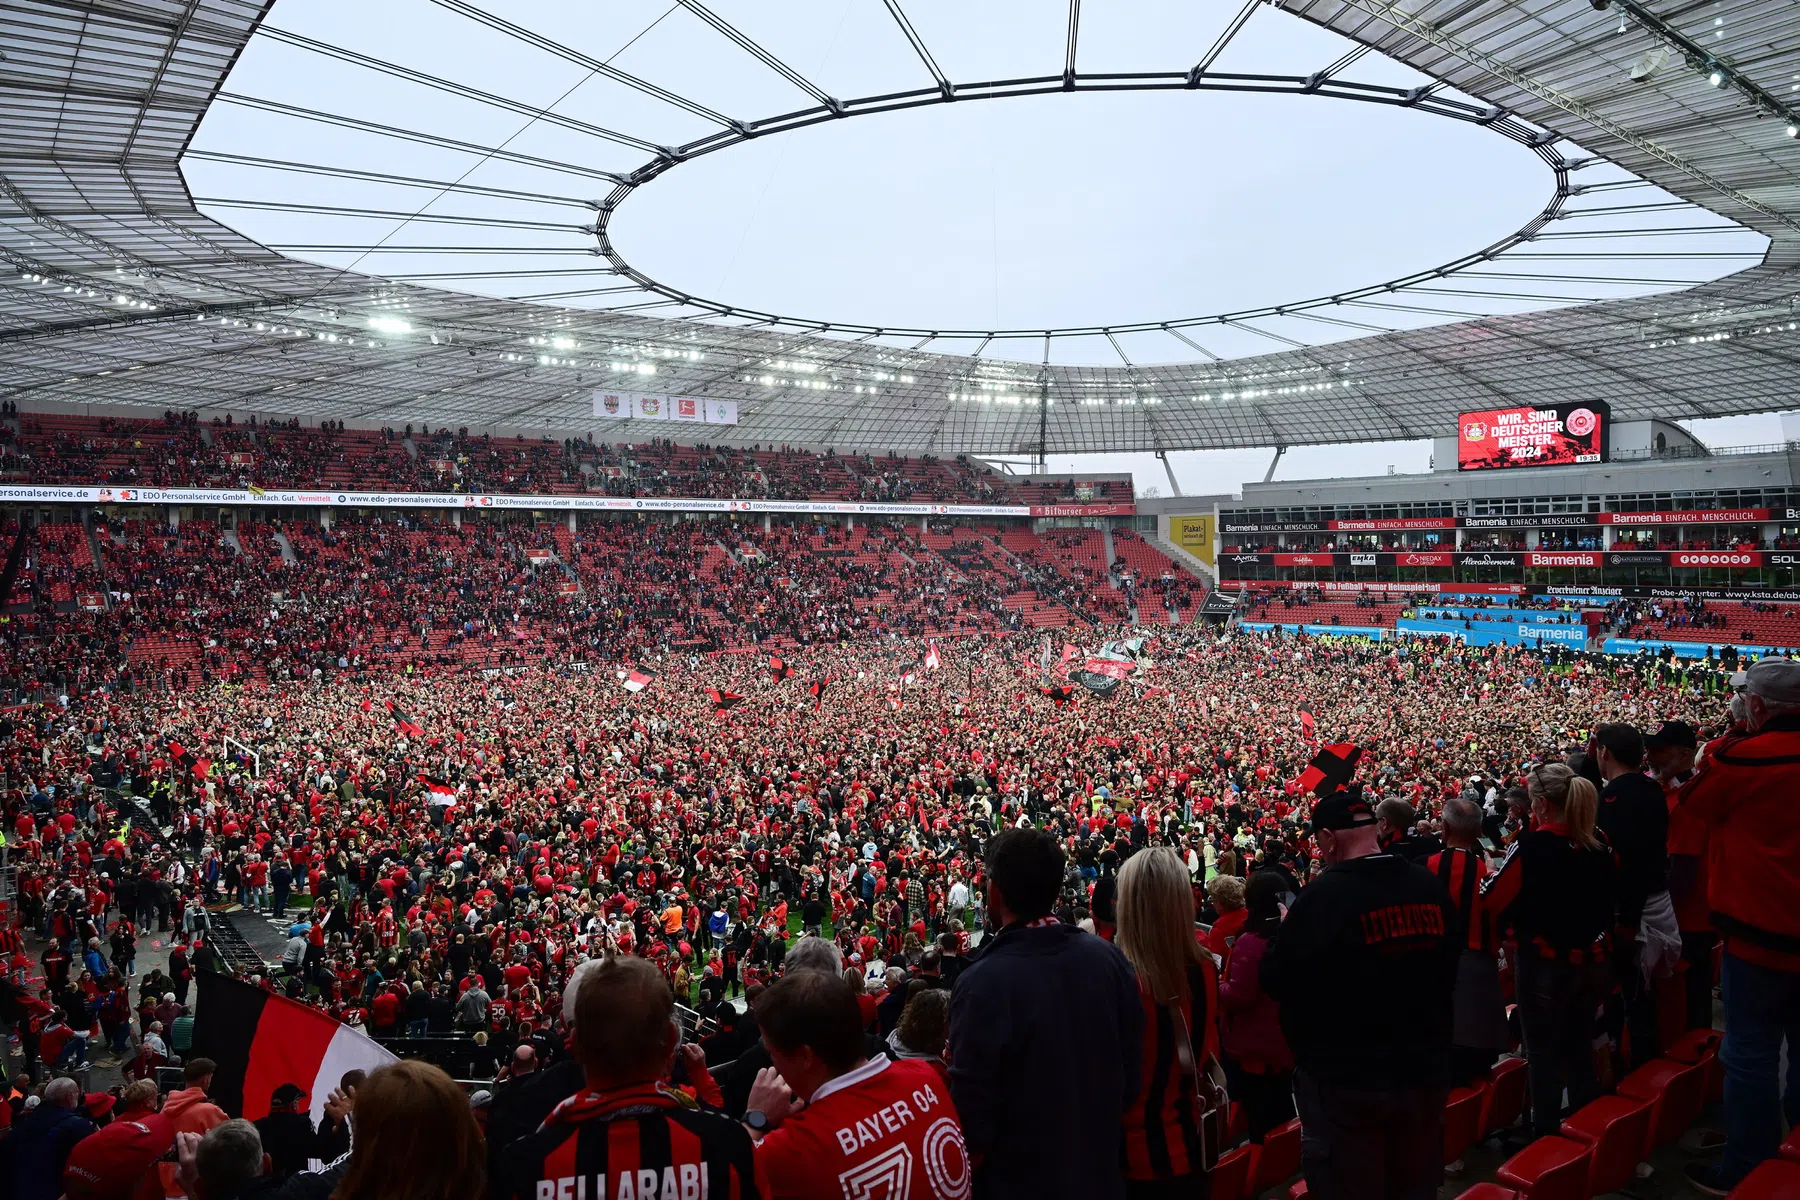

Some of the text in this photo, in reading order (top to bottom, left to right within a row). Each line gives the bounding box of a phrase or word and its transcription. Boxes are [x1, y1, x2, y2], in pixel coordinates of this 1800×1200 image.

[1498, 410, 1557, 425] WIR. SIND
[1491, 421, 1563, 437] DEUTSCHER
[1498, 434, 1555, 448] MEISTER.
[1511, 446, 1542, 459] 2024
[143, 492, 160, 500] EDO
[162, 492, 221, 500] Personalservice
[222, 493, 246, 501] GmbH
[253, 494, 281, 502] Einfach.
[350, 495, 457, 504] www.edo-personalservice.de
[509, 498, 552, 506] Personalservice
[575, 499, 594, 507] Einfach.
[645, 500, 725, 508] www.edo-personalservice.de
[1044, 507, 1082, 515] Bitburger
[1465, 517, 1588, 527] Barmenia EINFACH. MENSCHLICH.
[1613, 512, 1756, 523] Barmenia EINFACH. MENSCHLICH.
[1225, 524, 1259, 532] Barmenia
[1338, 521, 1375, 529] Barmenia
[1405, 520, 1445, 528] MENSCHLICH.
[1460, 554, 1515, 566] Alexanderwerk
[1532, 554, 1594, 565] Barmenia
[1388, 583, 1425, 591] Heimspiel
[1425, 583, 1440, 591] hat!
[1591, 586, 1623, 596] Anzeiger
[1651, 589, 1800, 599] Probe-Abo unter: www.ksta.de/ab
[1537, 615, 1580, 625] Barmia
[1519, 625, 1583, 640] Barmenia
[835, 1083, 939, 1156] BAYER 04
